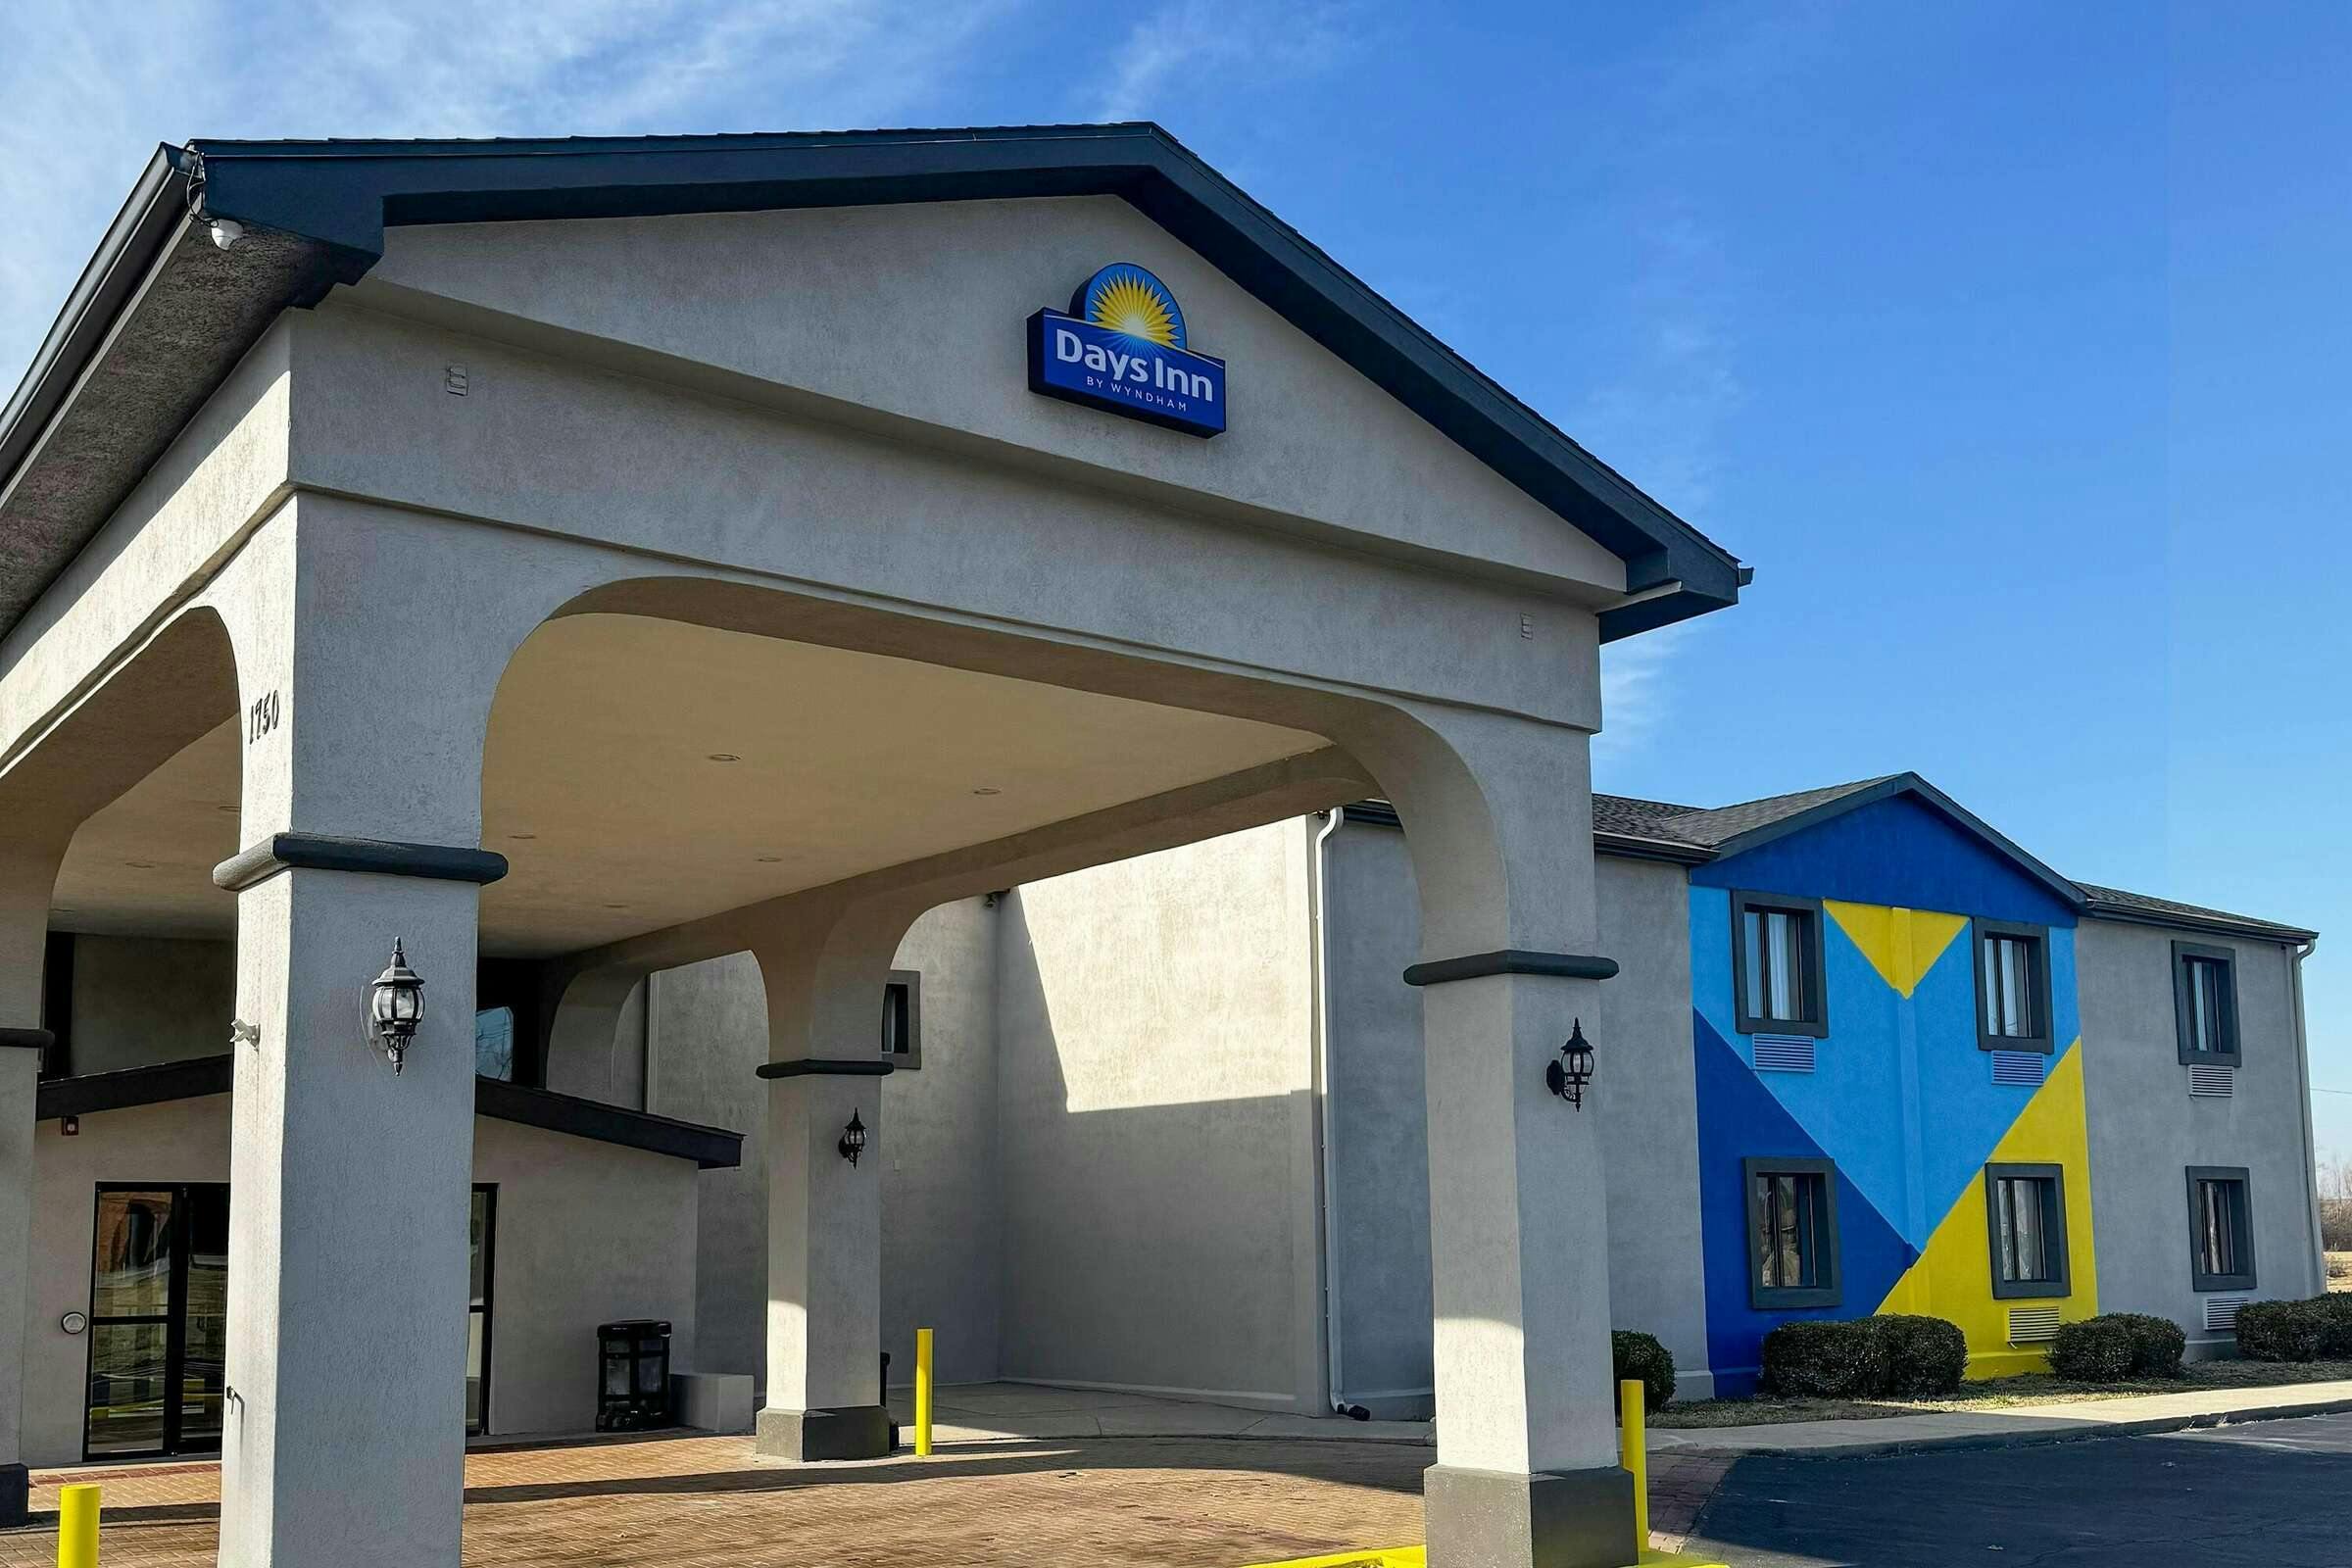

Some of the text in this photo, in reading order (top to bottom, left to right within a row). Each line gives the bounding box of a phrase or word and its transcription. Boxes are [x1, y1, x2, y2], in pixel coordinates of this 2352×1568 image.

[1056, 328, 1213, 402] Days Inn
[1086, 375, 1187, 412] BY WYNDHAM
